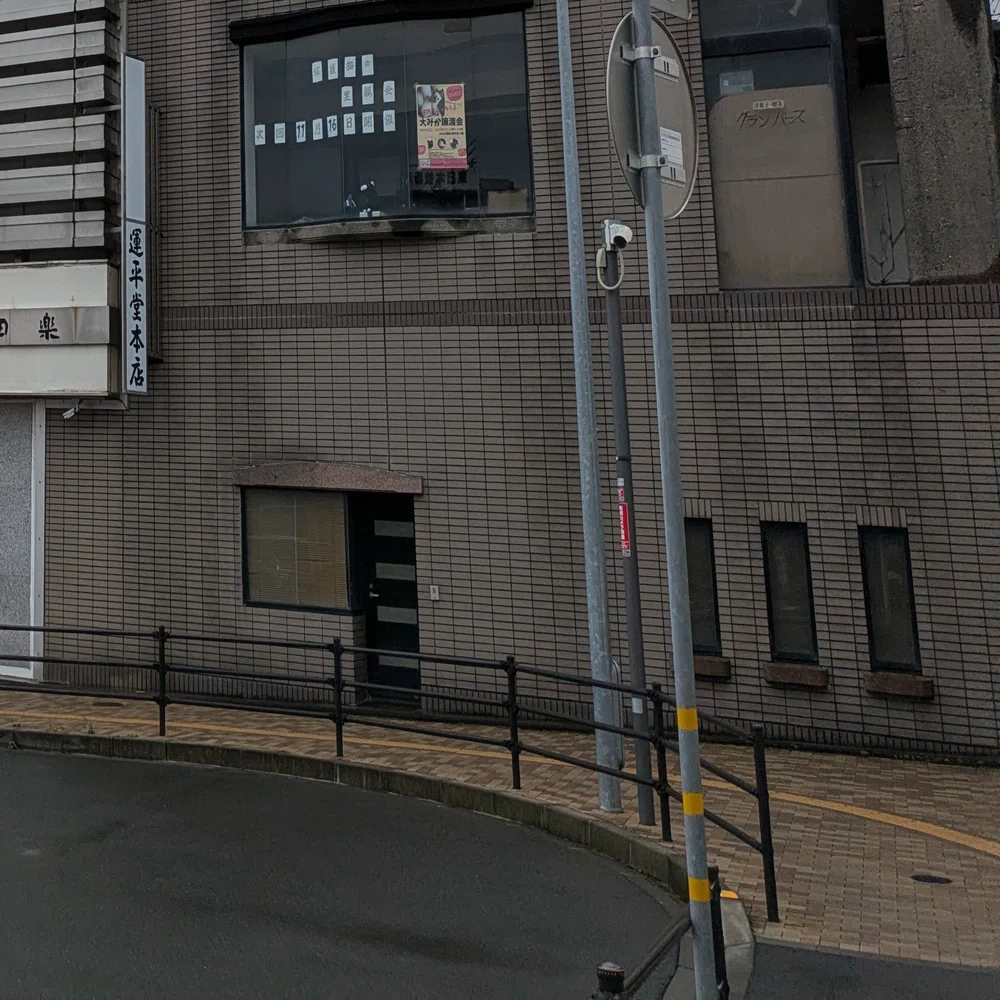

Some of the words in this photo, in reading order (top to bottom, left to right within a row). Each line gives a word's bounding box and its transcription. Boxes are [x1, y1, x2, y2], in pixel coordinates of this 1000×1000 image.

[128, 227, 145, 387] 運平堂本店
